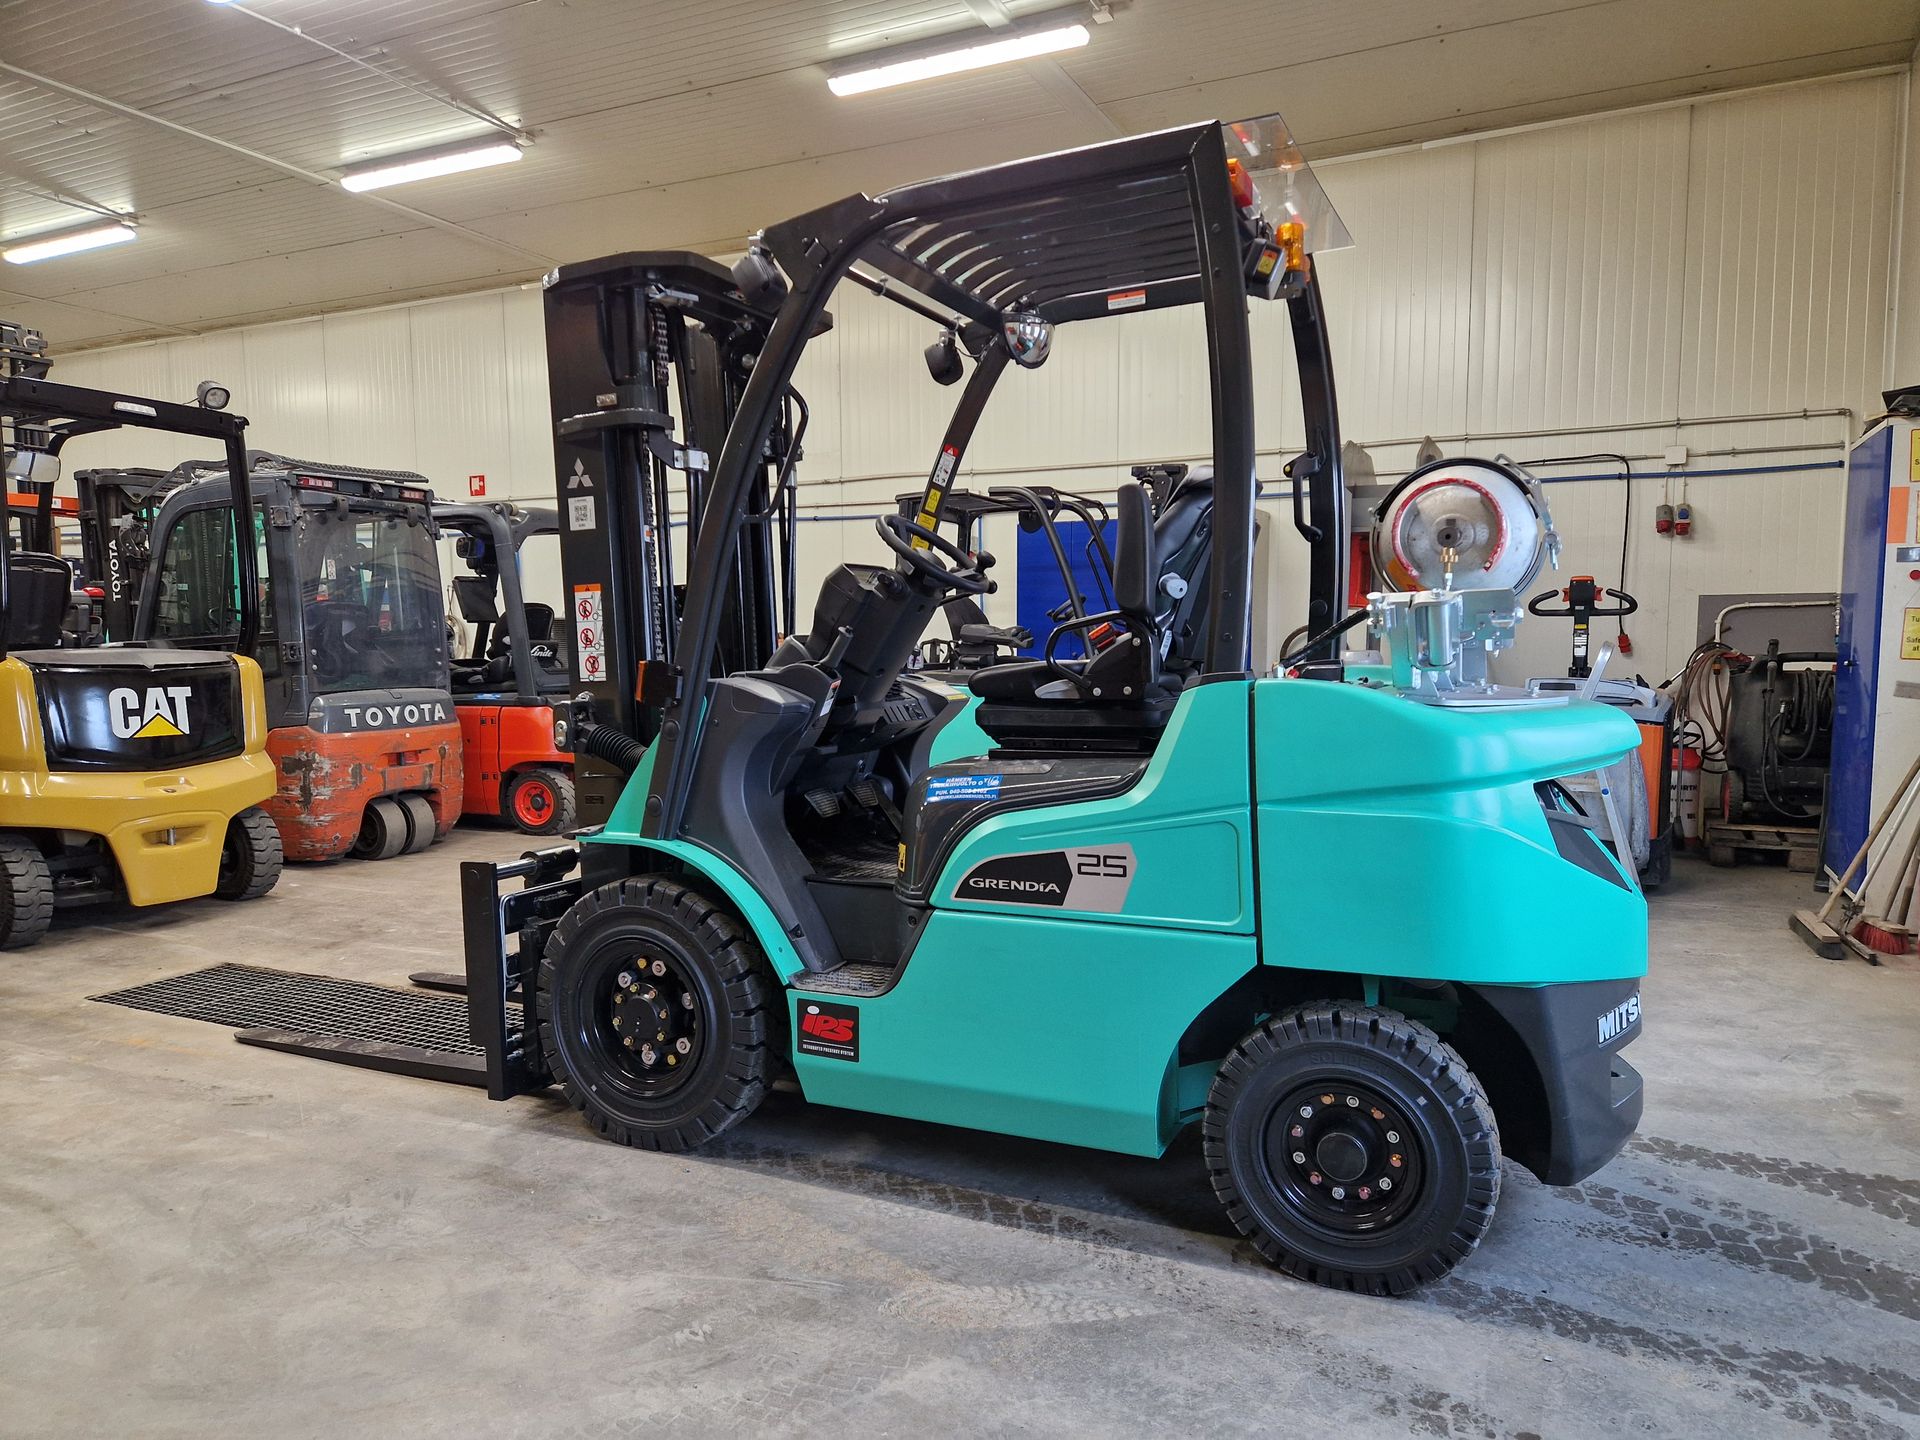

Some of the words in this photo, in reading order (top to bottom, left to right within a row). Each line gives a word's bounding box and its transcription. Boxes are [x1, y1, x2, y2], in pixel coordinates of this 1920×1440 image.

[108, 539, 121, 602] TOYOTA
[530, 644, 553, 657] Linde
[108, 686, 192, 739] CAT
[344, 702, 446, 728] TOYOTA
[1077, 853, 1127, 878] 25
[1598, 993, 1641, 1043] MITS
